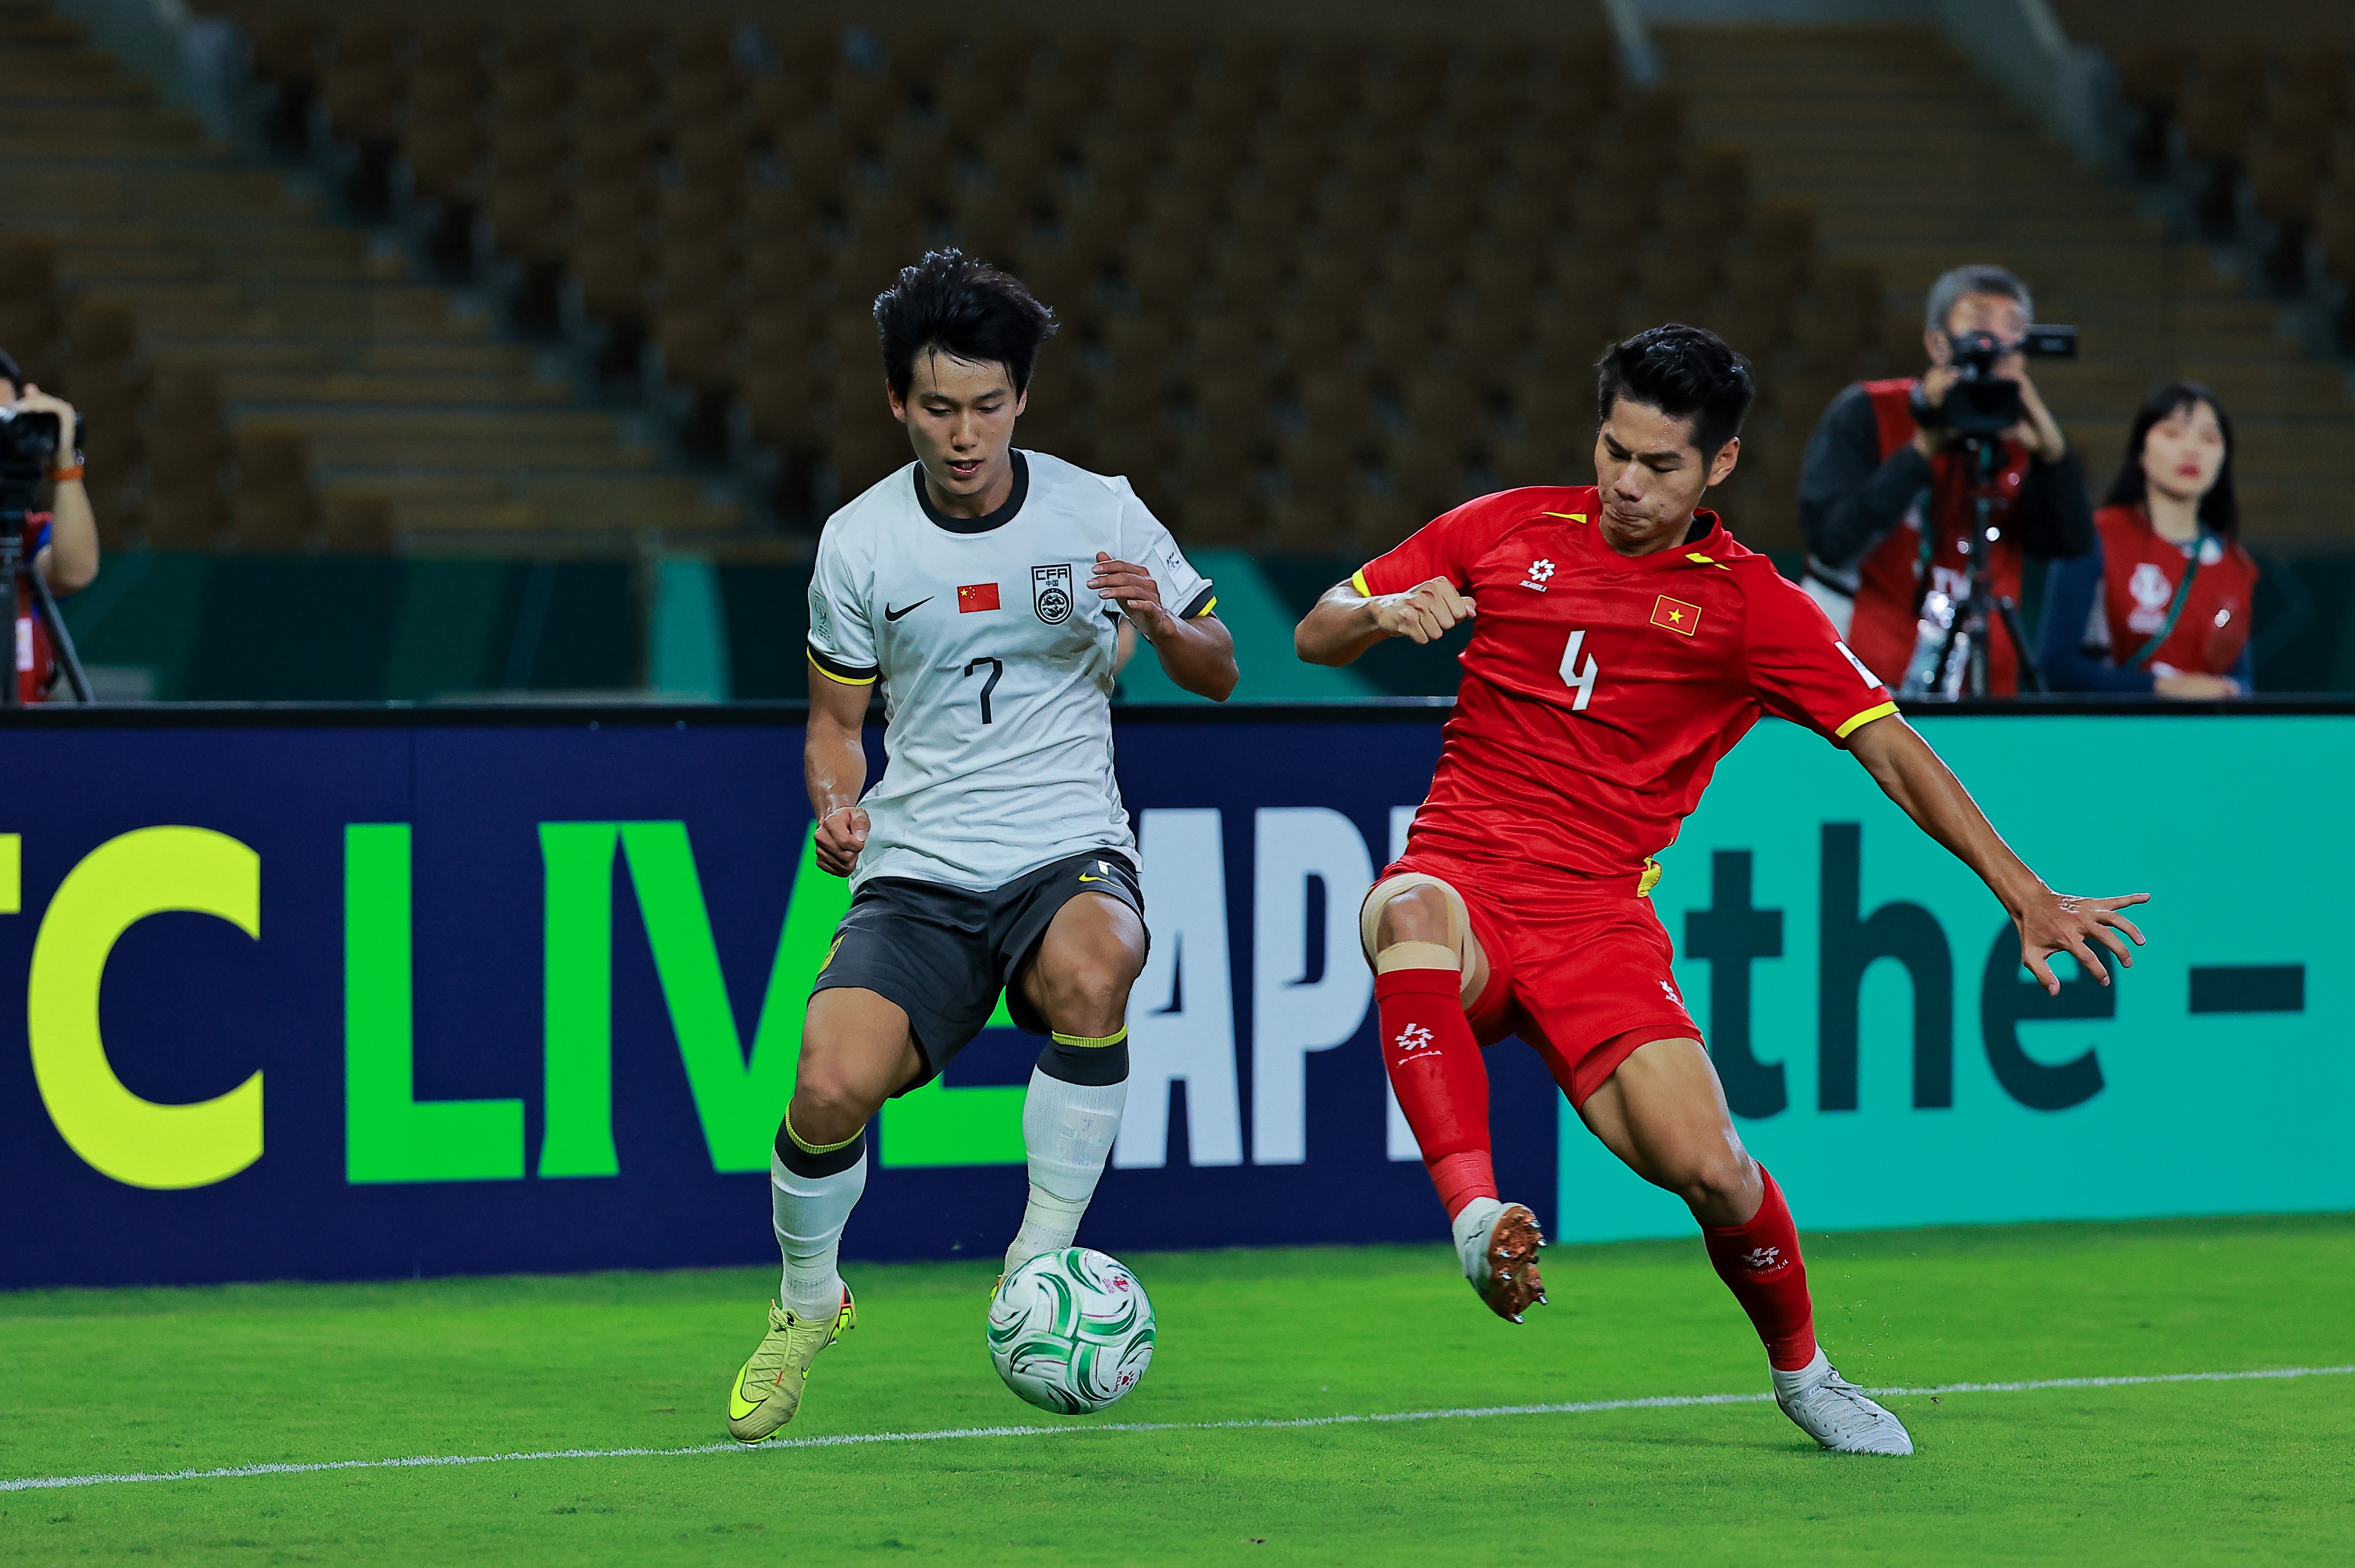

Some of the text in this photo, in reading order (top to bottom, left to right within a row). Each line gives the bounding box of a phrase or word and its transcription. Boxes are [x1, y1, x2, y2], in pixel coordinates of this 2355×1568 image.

[1036, 568, 1068, 580] CFA
[964, 657, 1003, 724] 7
[1558, 629, 1599, 711] 4
[0, 823, 265, 1190] C
[1684, 821, 2116, 1119] the
